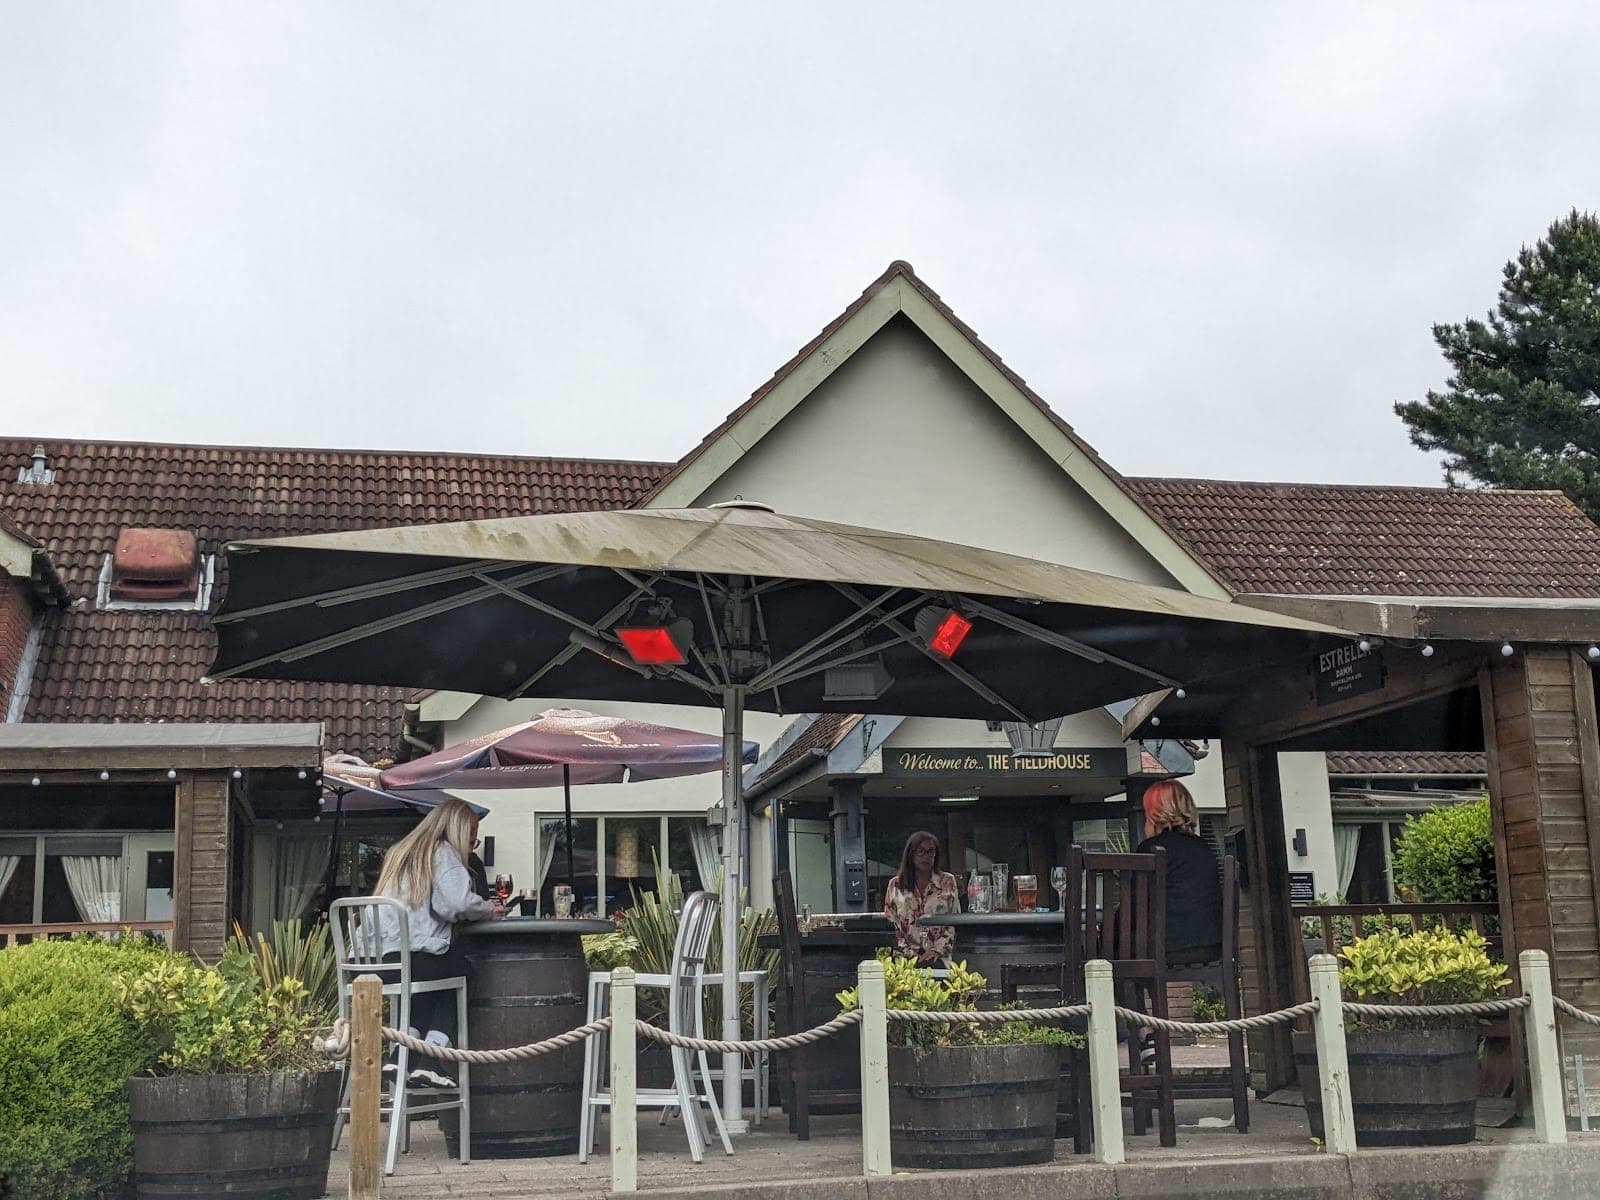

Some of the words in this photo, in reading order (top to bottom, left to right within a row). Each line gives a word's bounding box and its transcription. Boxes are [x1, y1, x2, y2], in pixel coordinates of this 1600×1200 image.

[899, 752, 961, 770] Welcome
[986, 754, 1010, 770] THE
[1013, 753, 1091, 770] FIELDHOUSE
